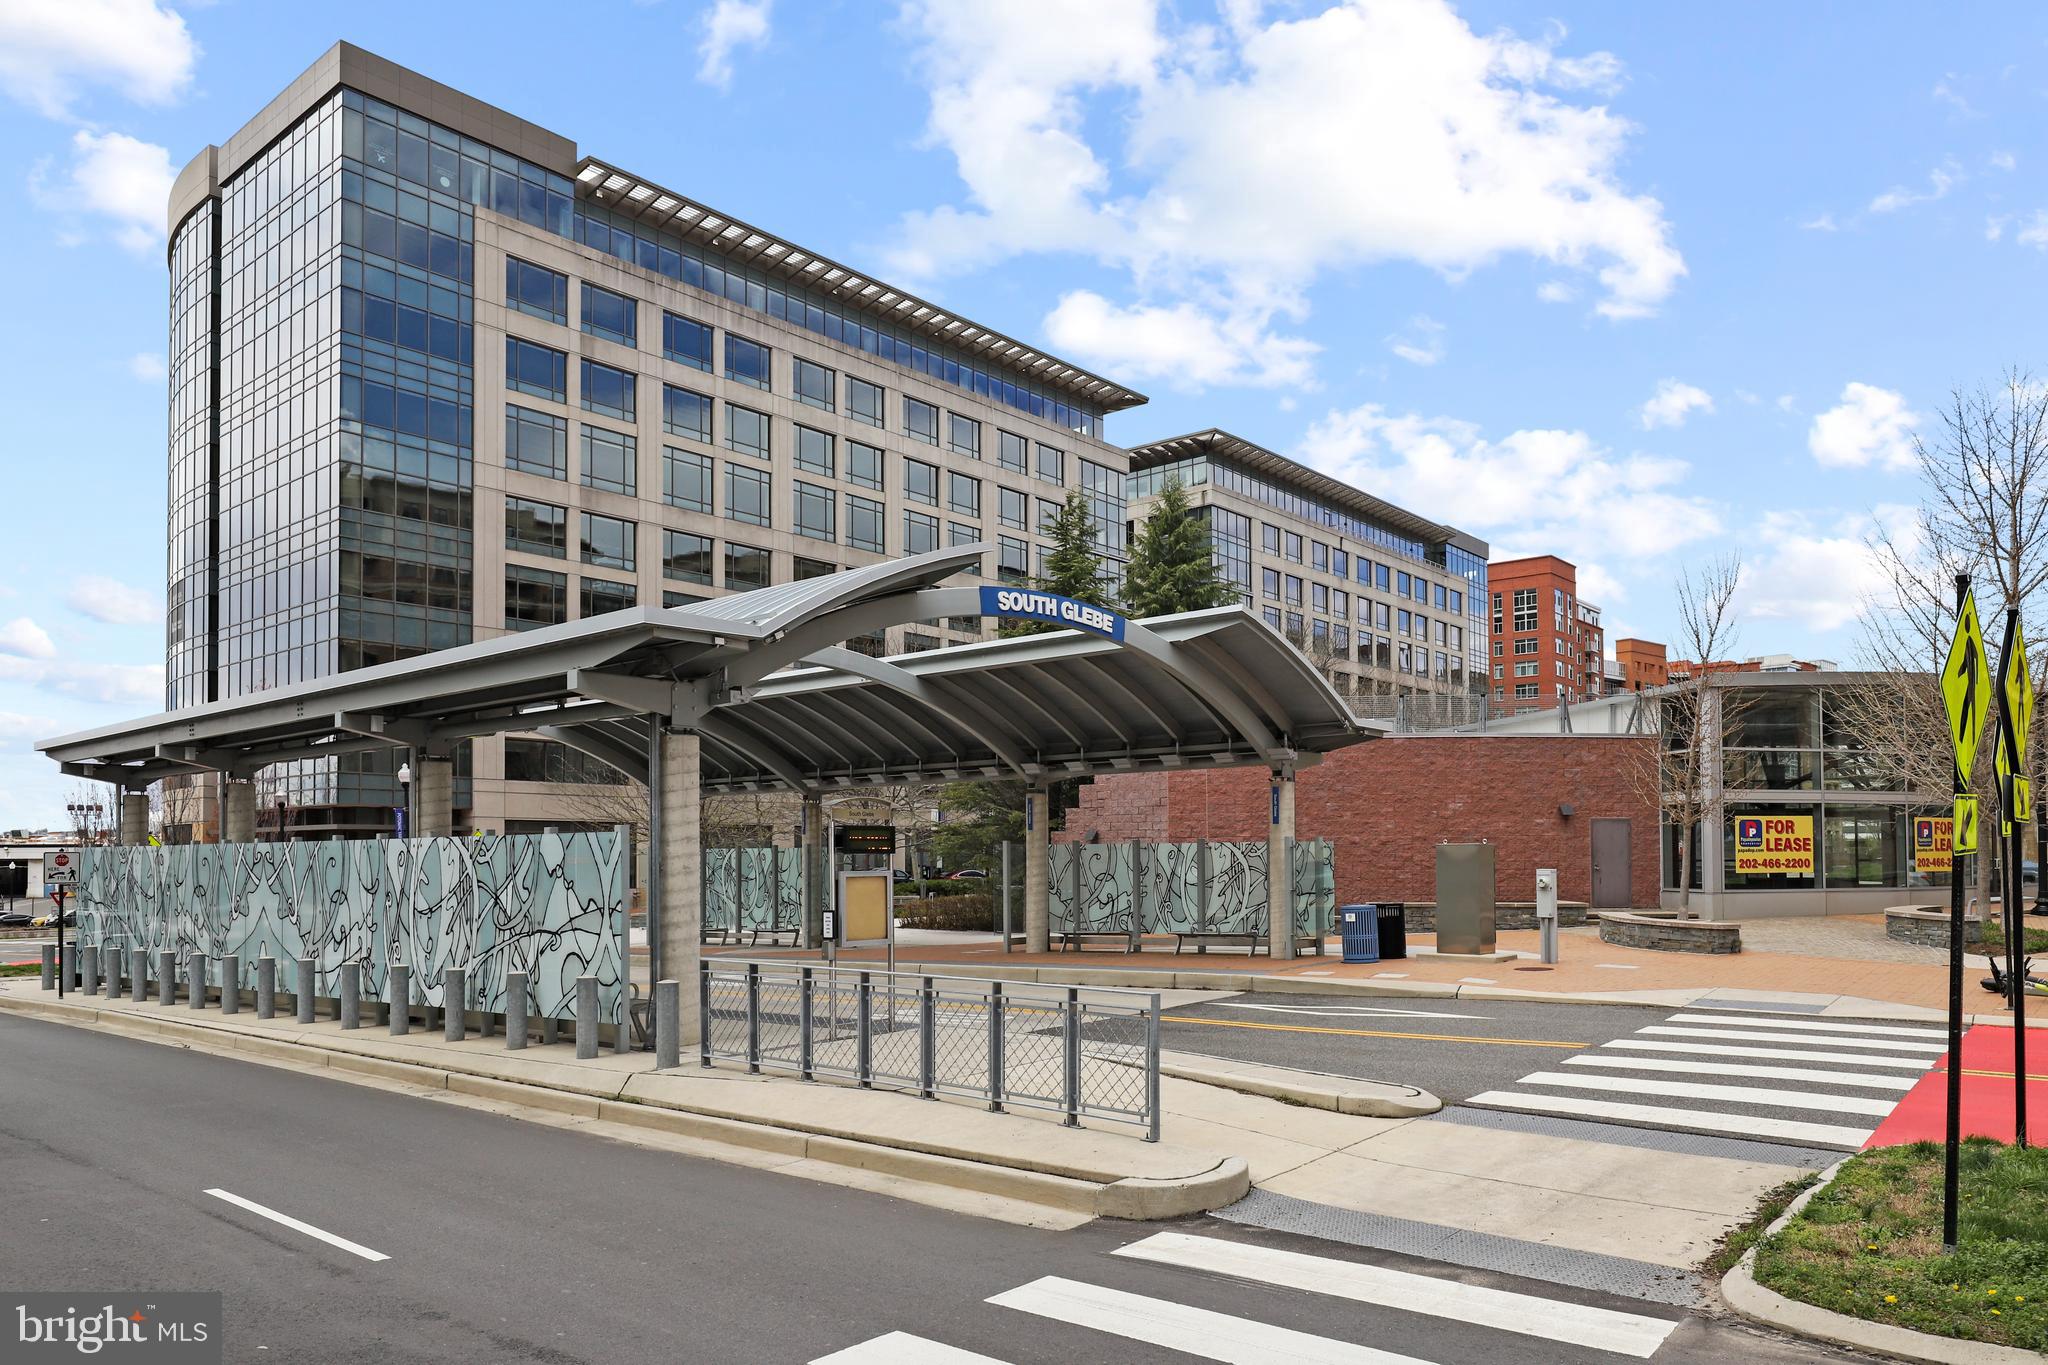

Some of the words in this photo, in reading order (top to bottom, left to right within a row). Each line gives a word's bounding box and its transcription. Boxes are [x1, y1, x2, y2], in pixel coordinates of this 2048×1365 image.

[997, 591, 1057, 616] SOUTH
[1061, 601, 1114, 633] GLEBE
[1765, 820, 1795, 834] FOR
[1766, 838, 1811, 852] LEASE
[1934, 838, 1952, 851] LEA
[1739, 858, 1811, 869] 202-466-2200
[1917, 857, 1952, 867] 202-466-2
